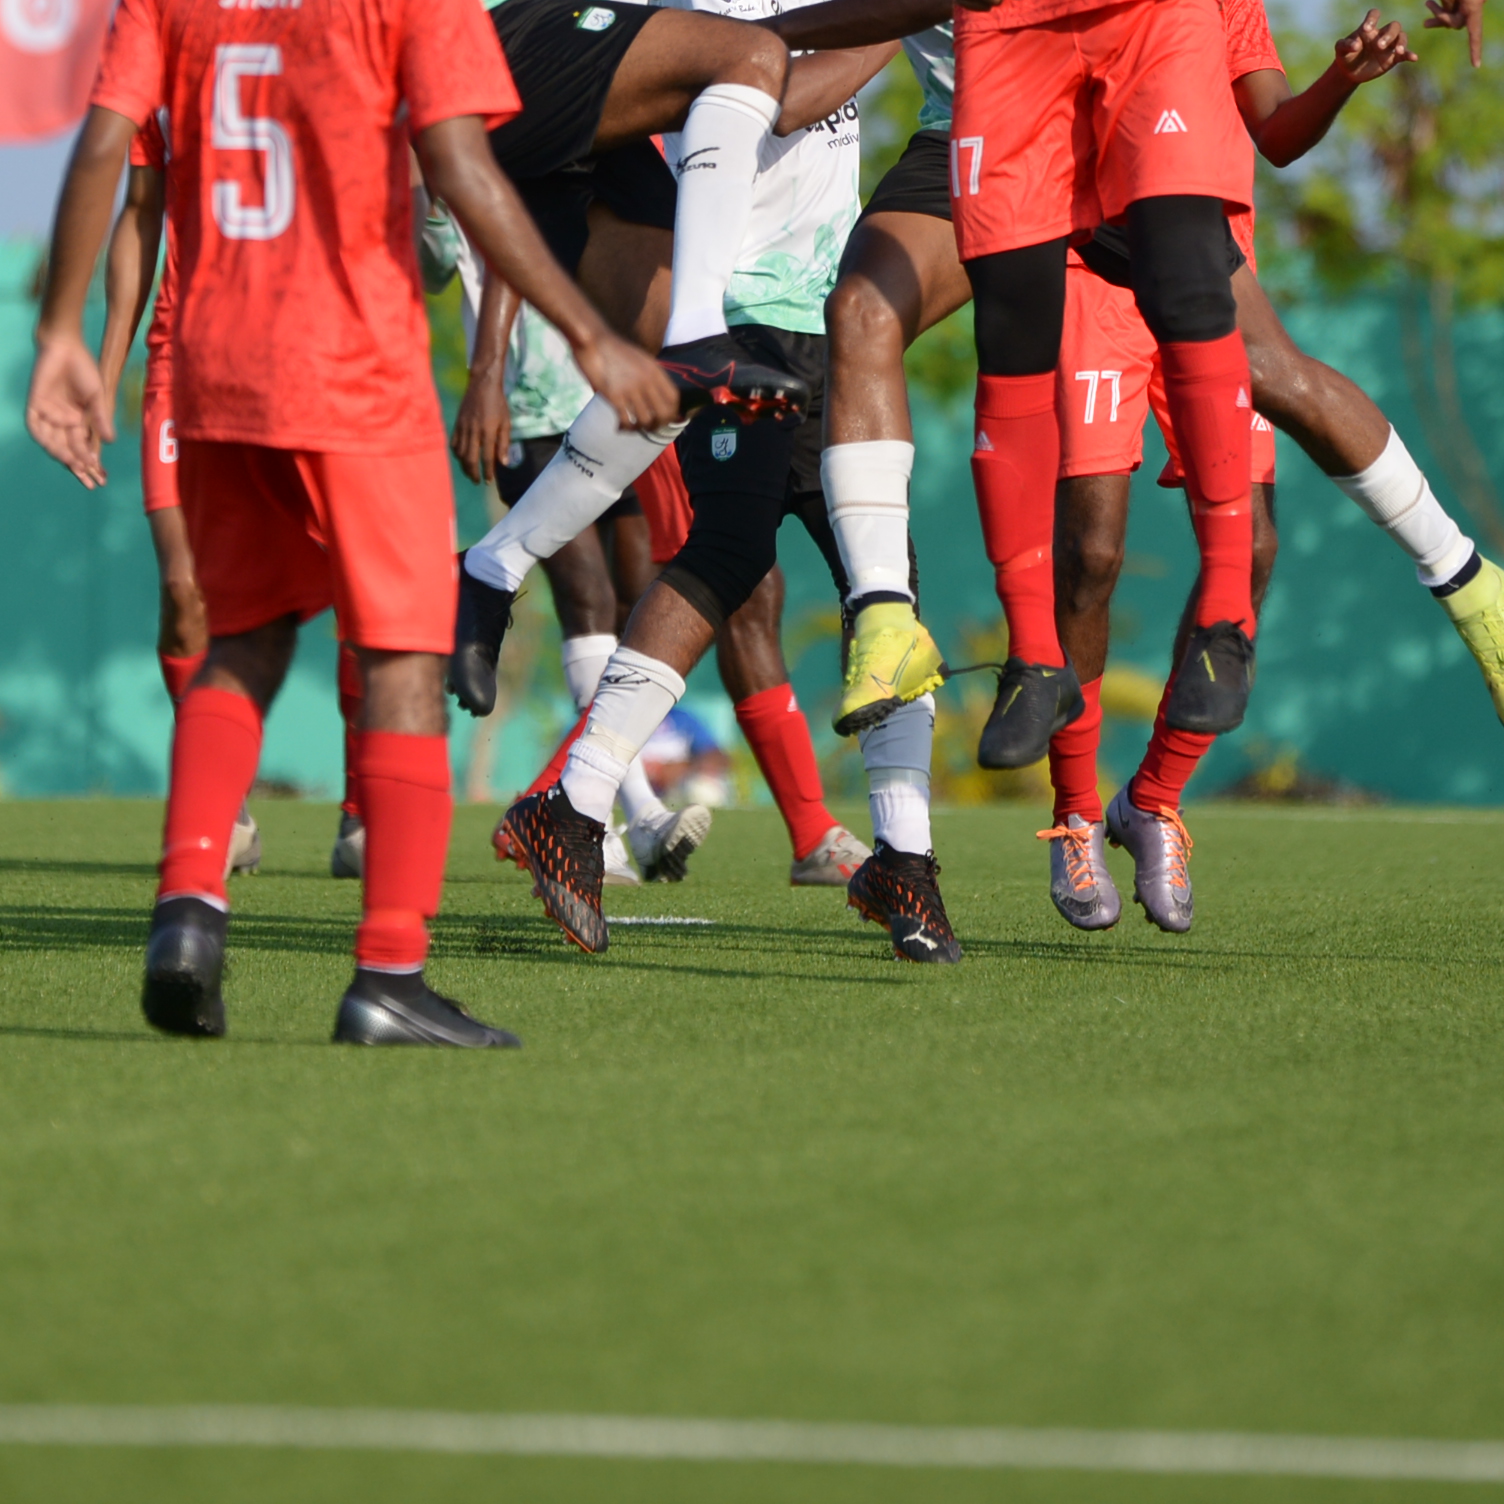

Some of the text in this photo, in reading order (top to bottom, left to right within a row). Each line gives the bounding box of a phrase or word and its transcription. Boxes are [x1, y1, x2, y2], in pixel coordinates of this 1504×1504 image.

[212, 43, 295, 241] 5
[1074, 370, 1122, 424] 77
[158, 418, 180, 465] 6
